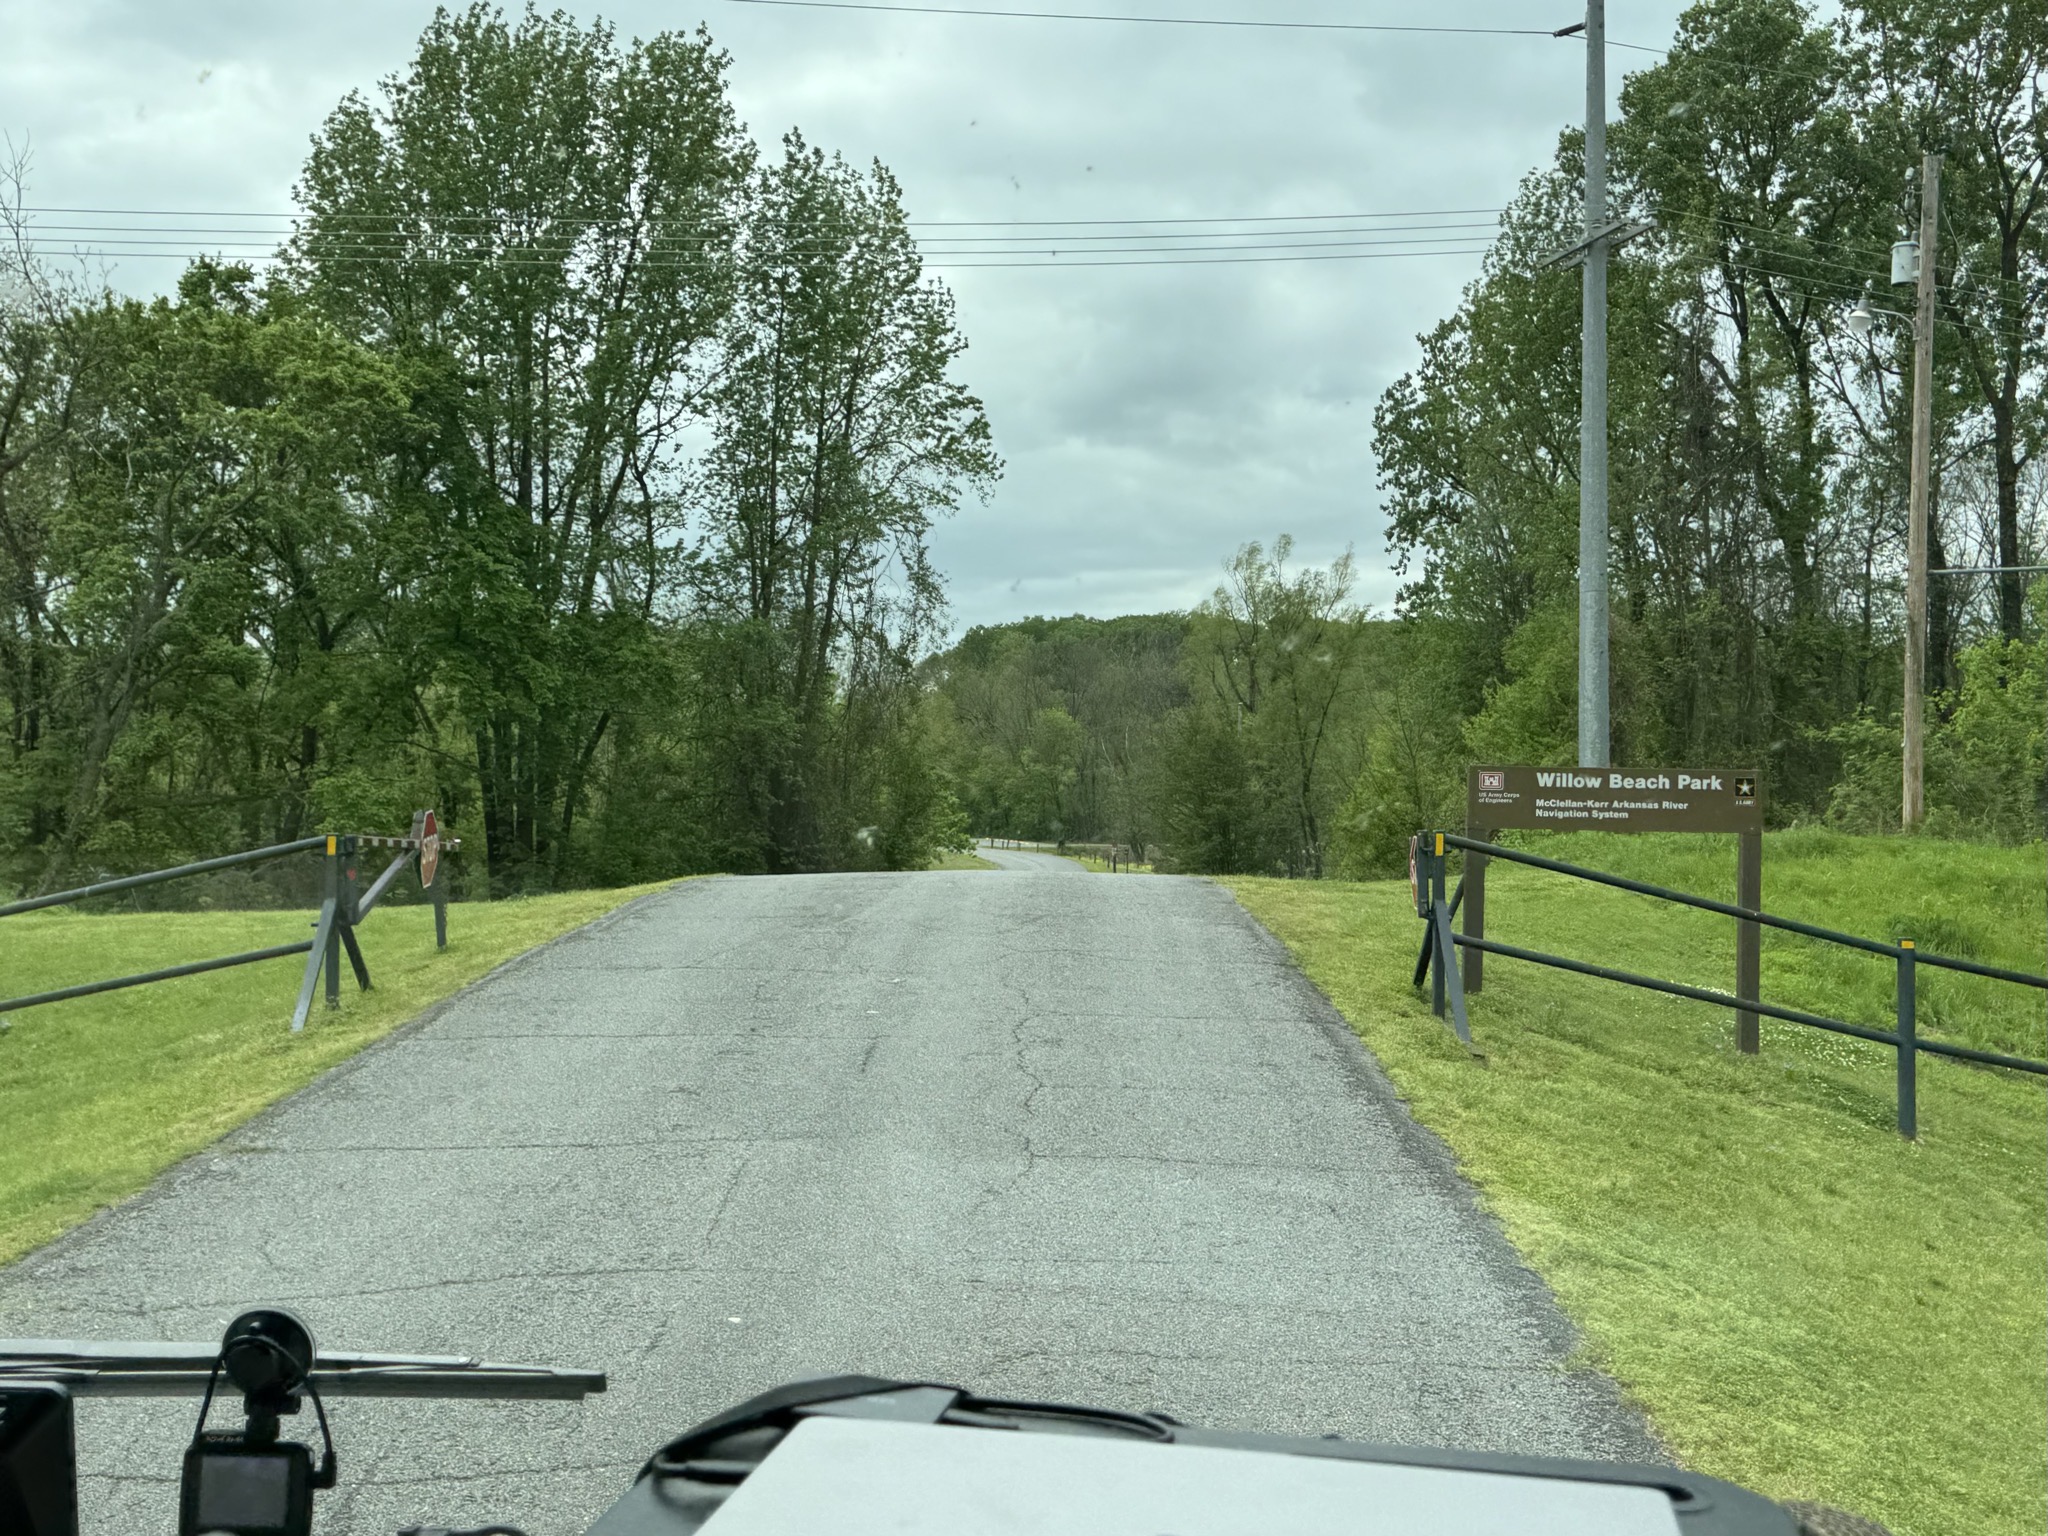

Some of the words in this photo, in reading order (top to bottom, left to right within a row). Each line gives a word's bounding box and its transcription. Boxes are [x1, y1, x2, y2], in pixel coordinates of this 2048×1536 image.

[1536, 772, 1603, 789] Willow
[1609, 773, 1670, 790] Beach
[1677, 774, 1723, 791] Park
[1535, 799, 1609, 808] McClellan-Kerr
[1612, 800, 1659, 810] Arkansas
[1662, 801, 1689, 810] River
[1535, 809, 1589, 819] Navigation
[1591, 809, 1629, 820] System
